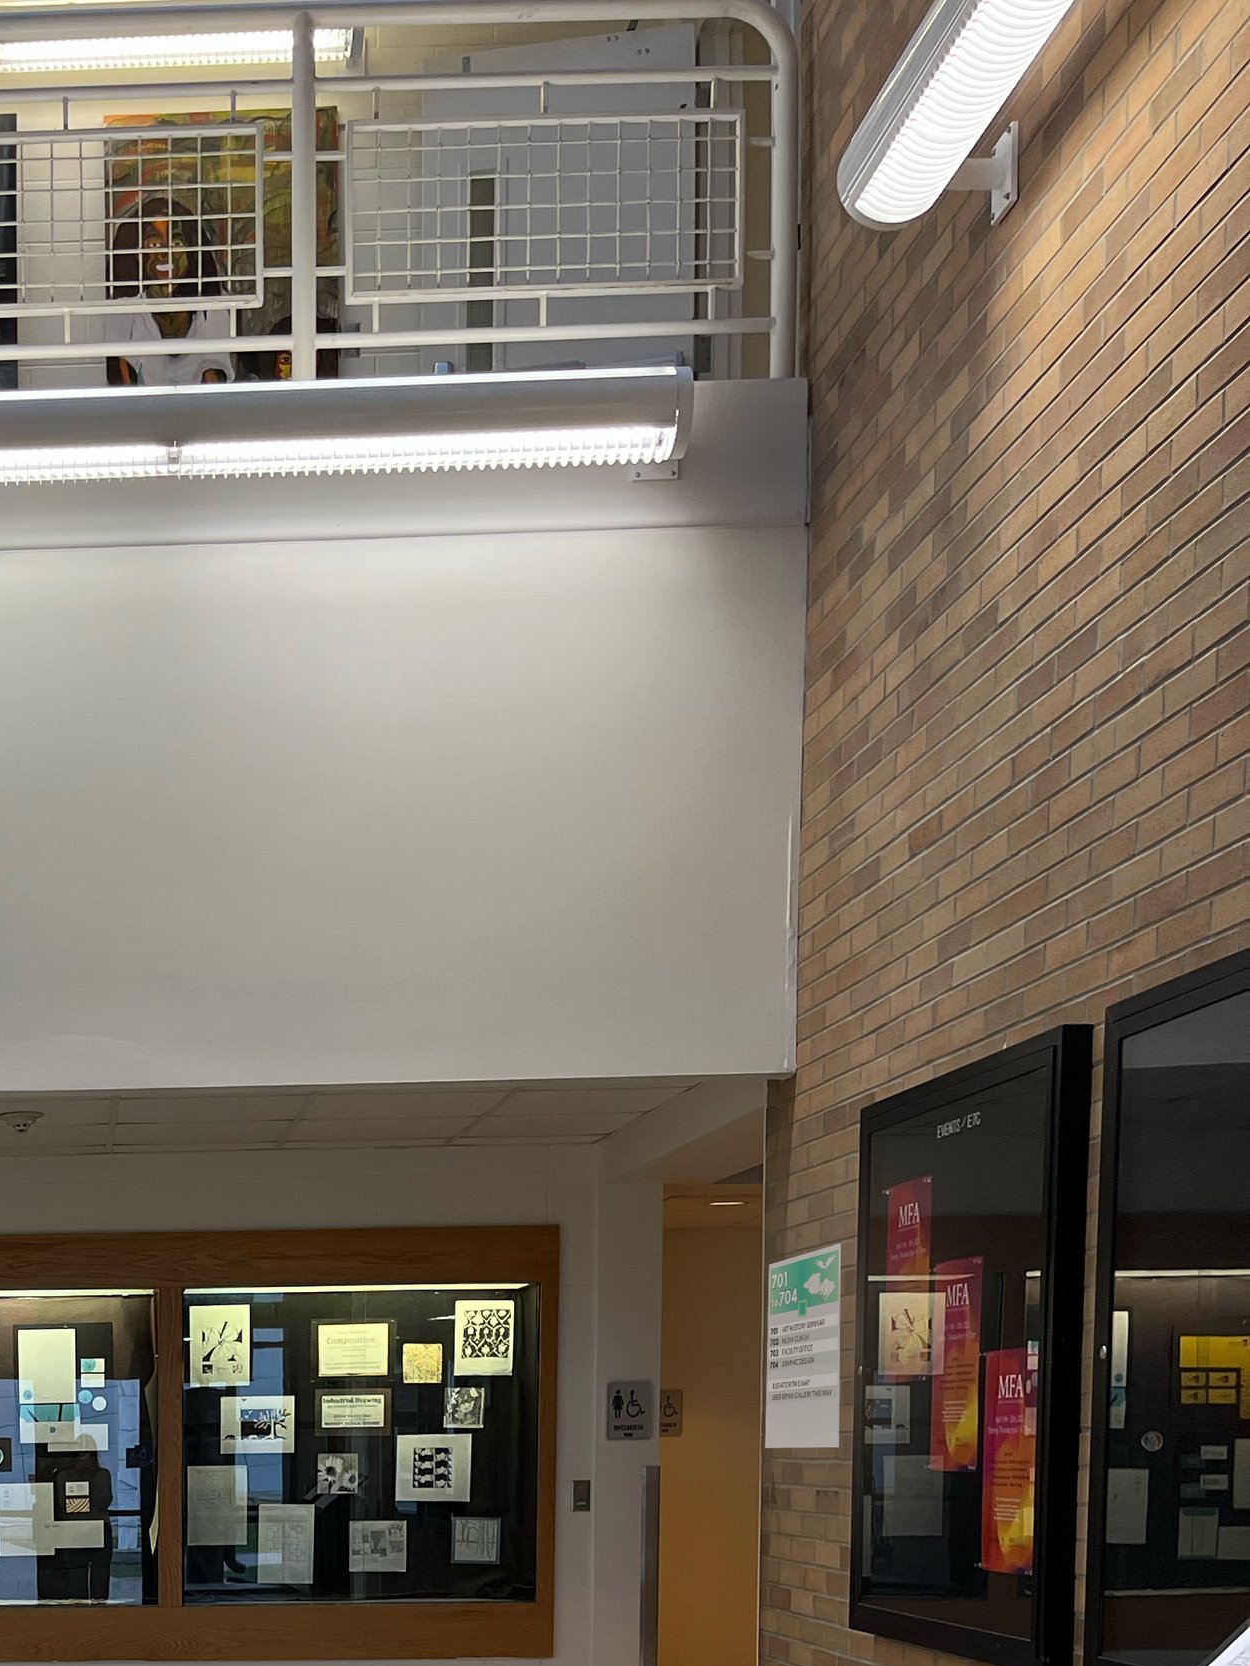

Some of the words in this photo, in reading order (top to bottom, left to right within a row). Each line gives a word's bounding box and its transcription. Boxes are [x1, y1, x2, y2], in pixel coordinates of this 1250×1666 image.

[937, 1118, 960, 1138] EVENTS
[967, 1111, 981, 1128] ETC
[898, 1202, 920, 1228] MFA
[771, 1271, 788, 1289] 701
[771, 1298, 779, 1307] to
[779, 1288, 798, 1307] 704
[946, 1282, 969, 1307] MFA
[326, 1335, 375, 1345] Composition
[770, 1349, 779, 1358] 703
[782, 1346, 799, 1355] FACULTY
[799, 1344, 813, 1352] OFFICE
[770, 1361, 779, 1369] 704
[772, 1381, 791, 1389] ELEVATOR
[997, 1374, 1024, 1399] MFA
[355, 1395, 382, 1404] Drawing
